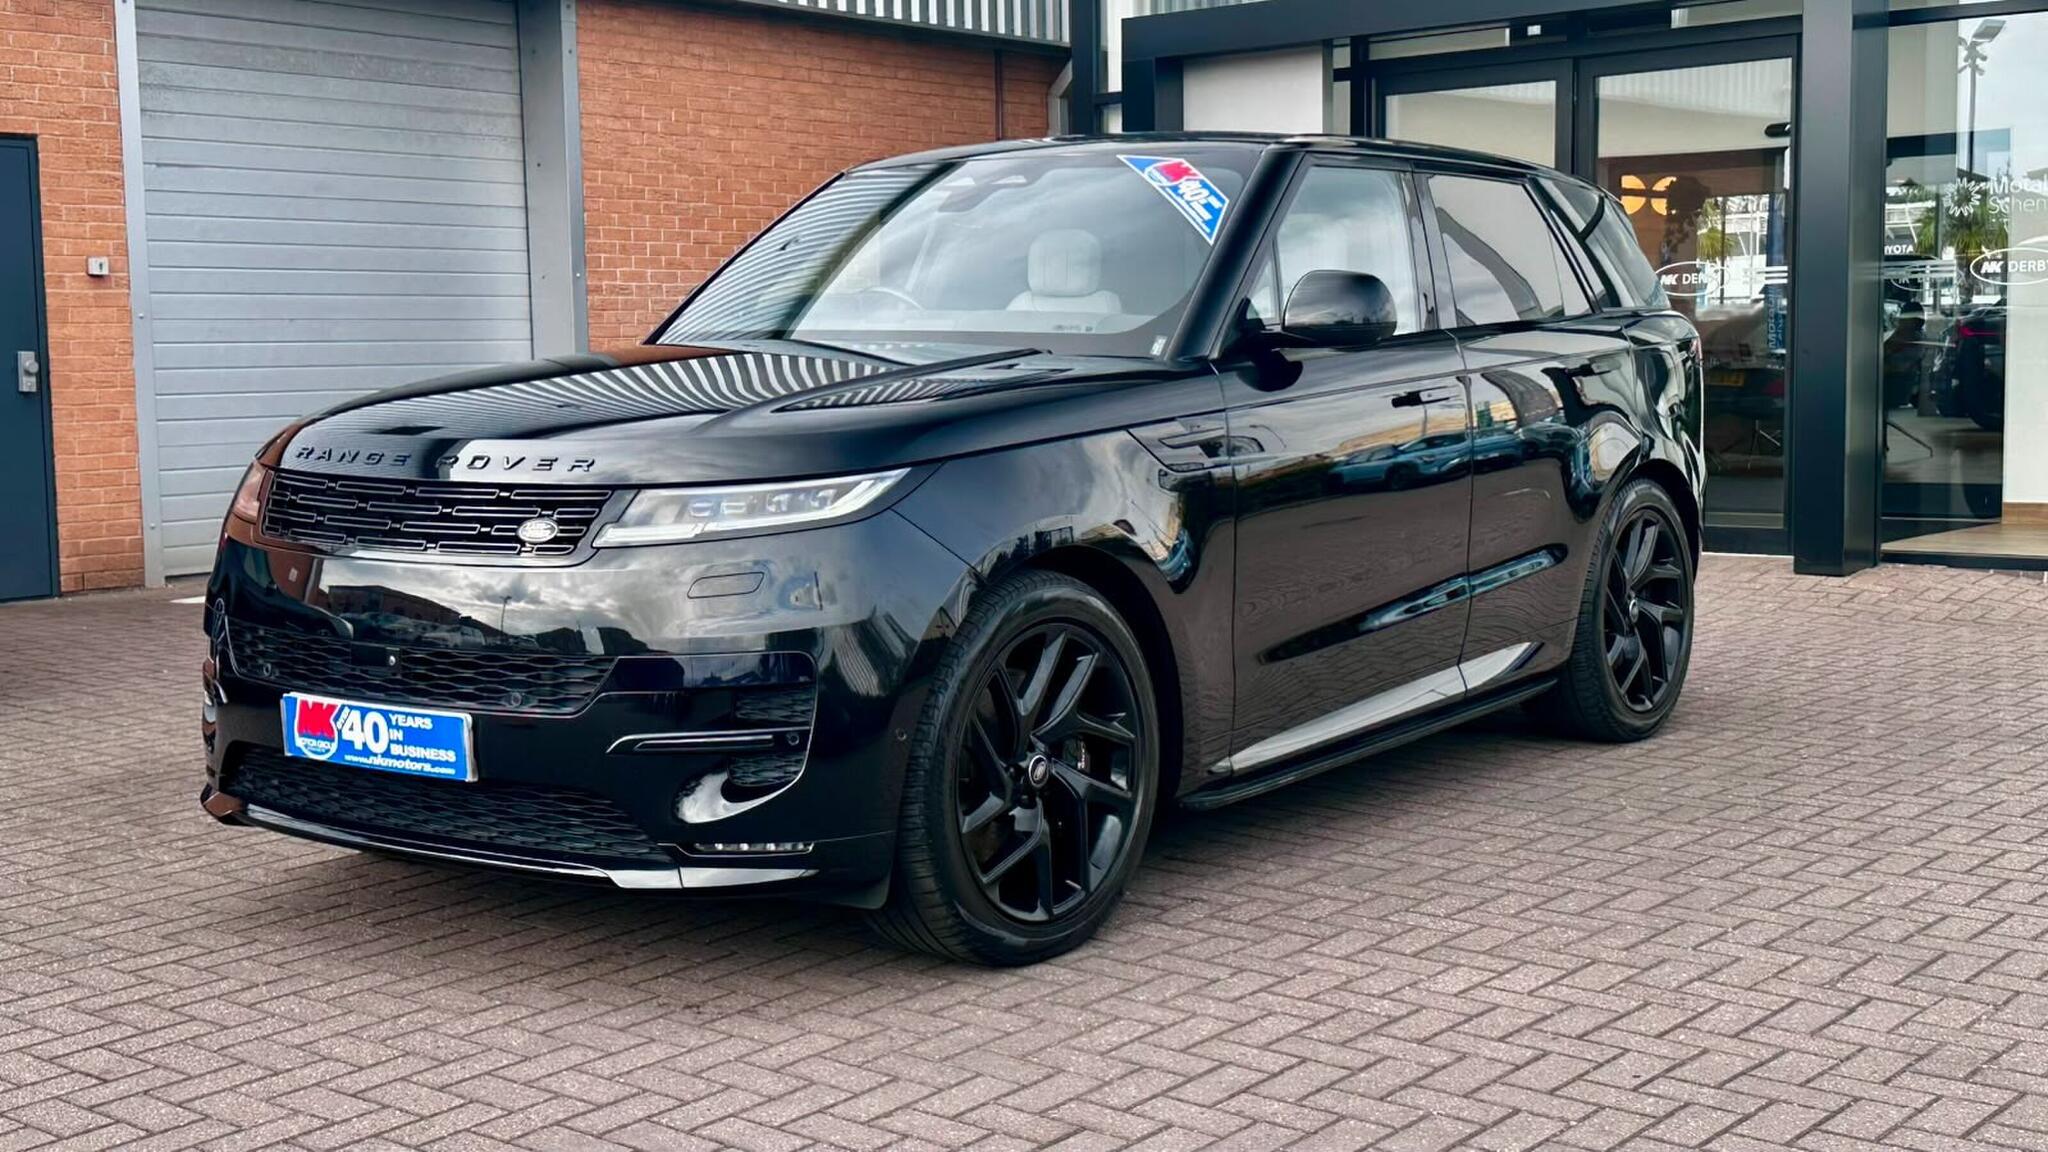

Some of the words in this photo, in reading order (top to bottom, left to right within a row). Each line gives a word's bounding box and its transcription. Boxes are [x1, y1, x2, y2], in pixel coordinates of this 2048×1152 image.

[1178, 180, 1210, 201] 40
[1884, 244, 1914, 255] YOTA
[1981, 261, 2004, 273] NK
[2008, 260, 2048, 272] DERB
[295, 447, 412, 467] RANGE
[435, 454, 596, 473] ROVER
[388, 713, 433, 730] YEARS
[341, 709, 389, 754] 40
[389, 728, 403, 741] IN
[390, 743, 456, 762] BUSINESS
[344, 753, 456, 775] www.nkmotors.com
